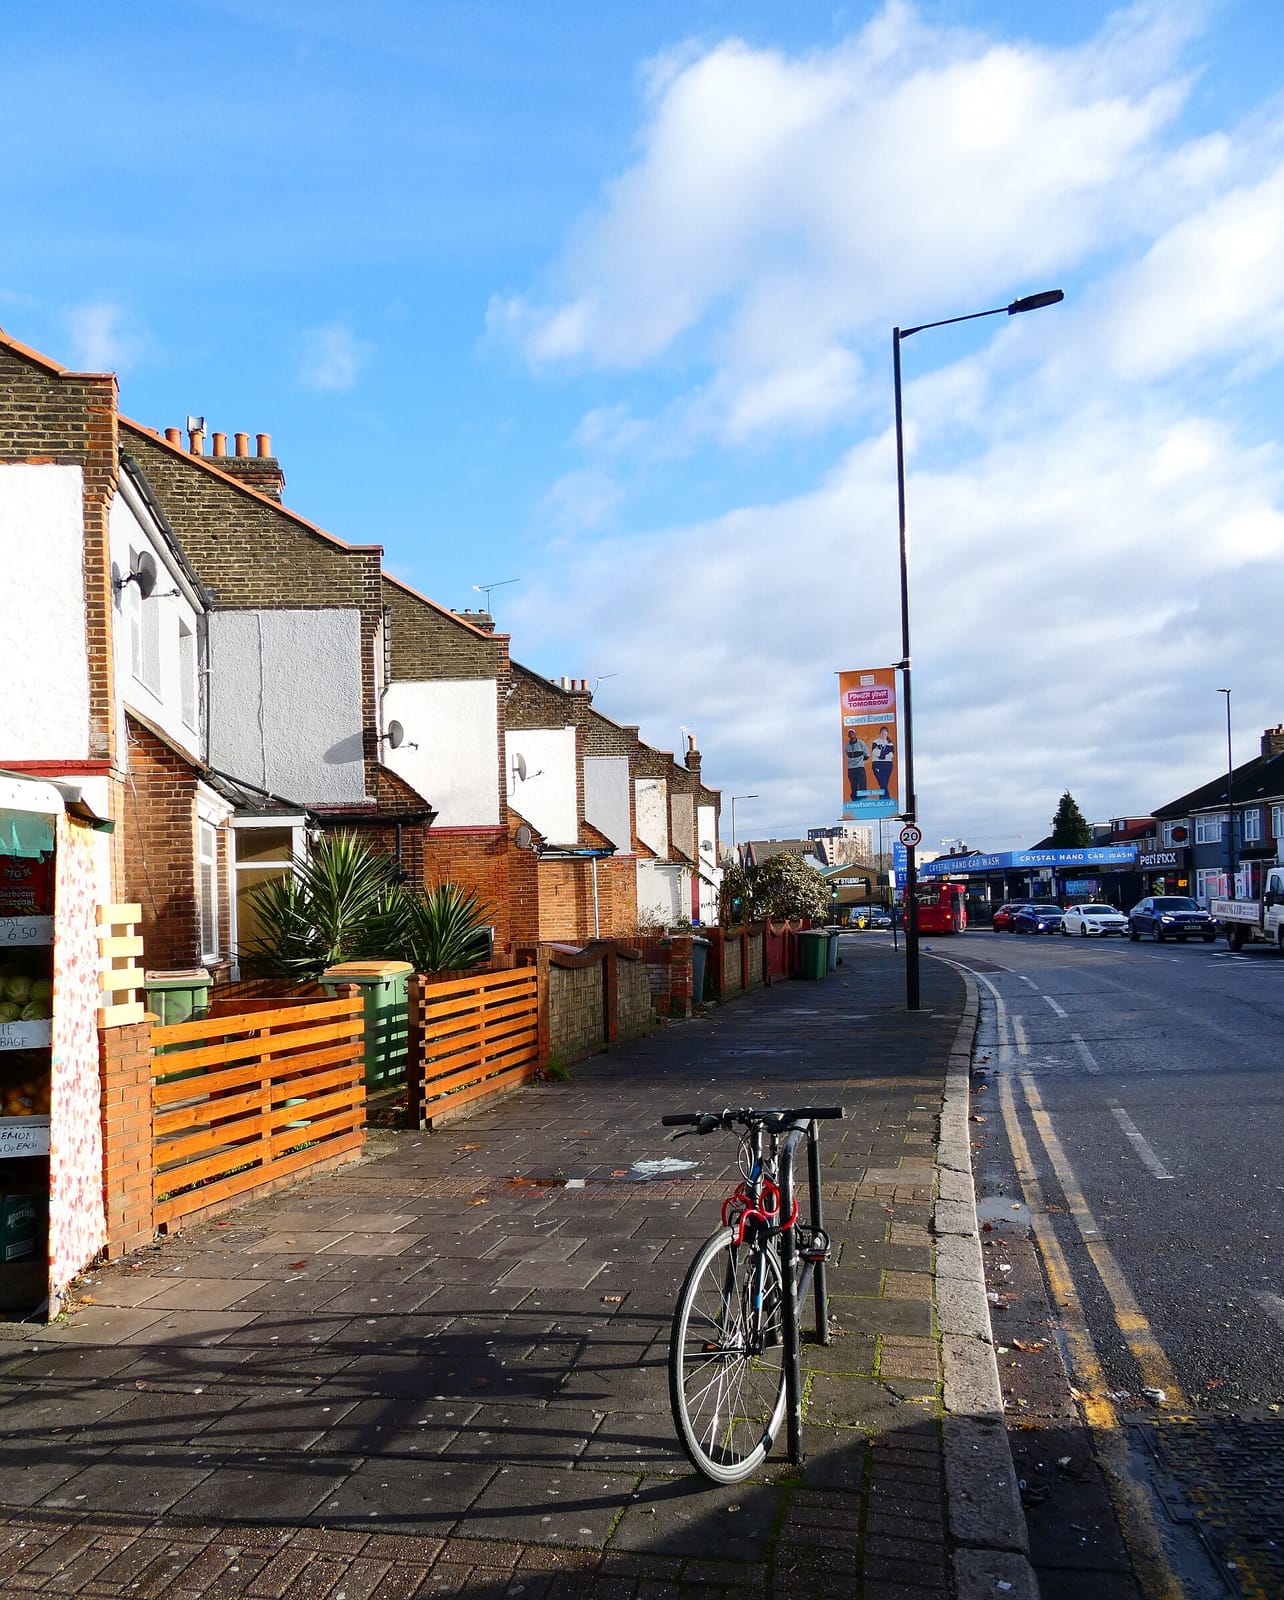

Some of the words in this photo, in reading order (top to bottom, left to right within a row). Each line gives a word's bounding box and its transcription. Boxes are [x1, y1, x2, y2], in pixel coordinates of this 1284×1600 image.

[848, 699, 889, 708] TOMORROW
[845, 716, 866, 724] Open
[867, 714, 893, 722] Events
[846, 799, 895, 808] newham.ac.uk
[903, 832, 918, 841] 20
[1019, 854, 1056, 862] CRYSTAL
[929, 864, 950, 872] CRYSTAL
[951, 861, 967, 869] HAND
[968, 859, 980, 868] CAR
[981, 856, 1000, 866] WASH
[8, 927, 37, 940] 6.50
[0, 1131, 36, 1140] EMON
